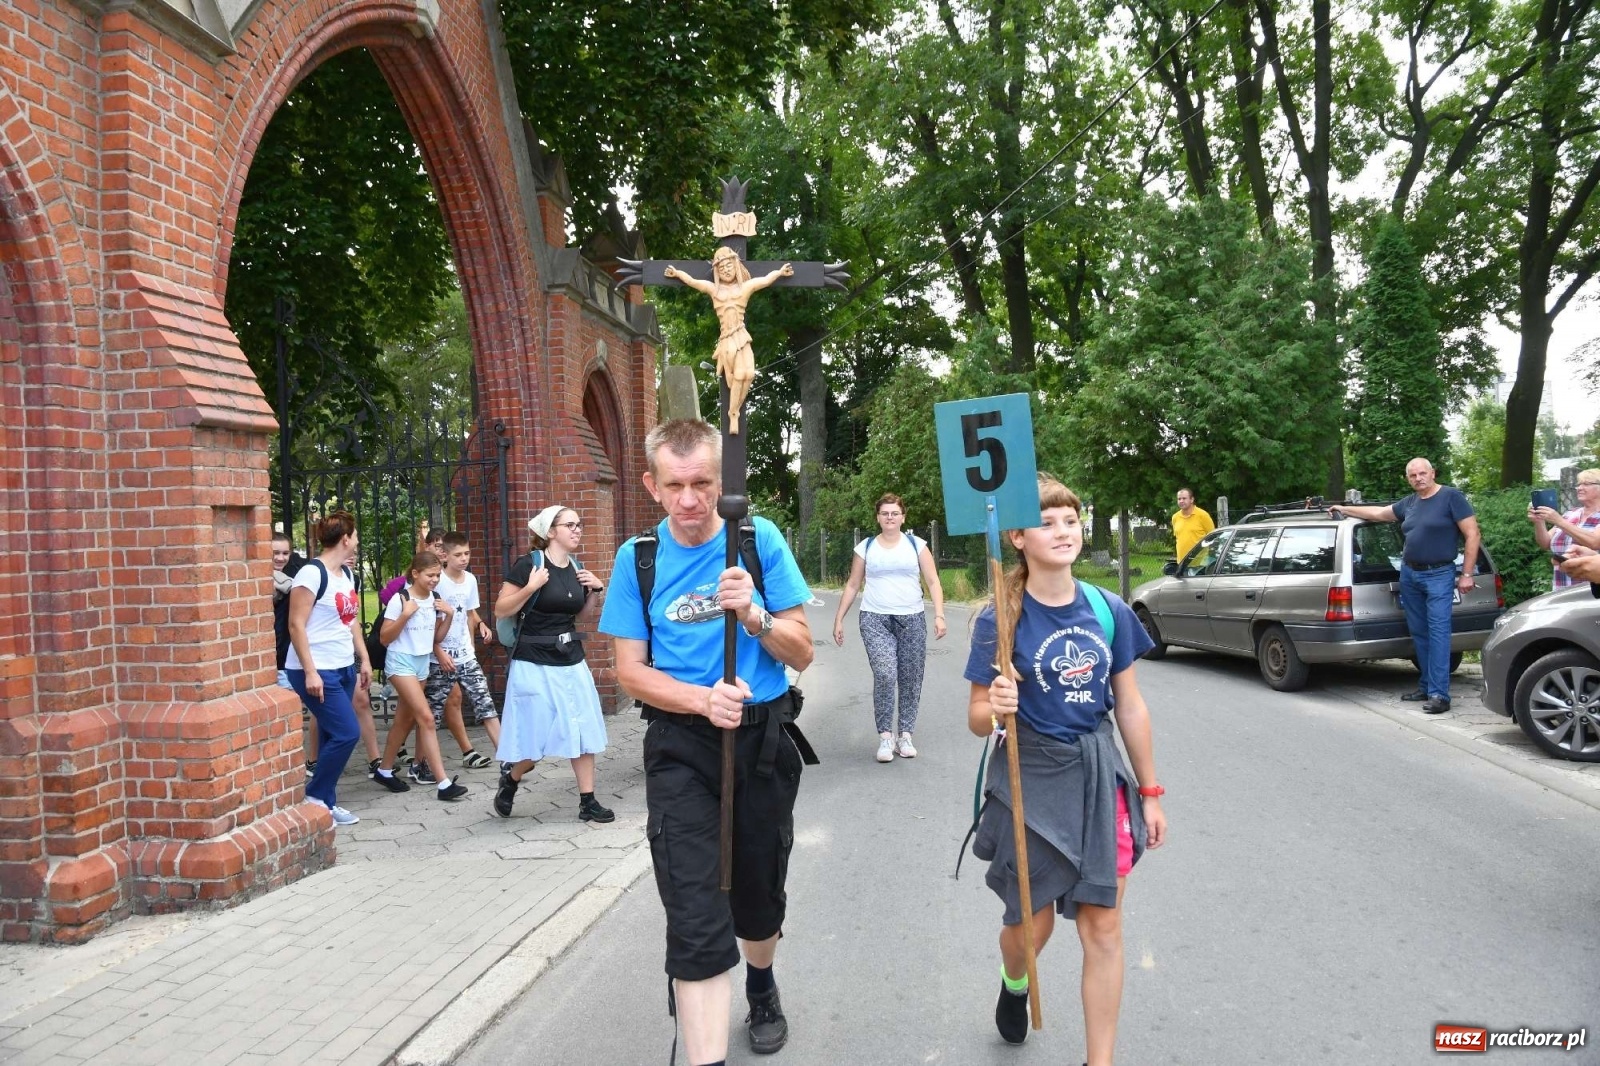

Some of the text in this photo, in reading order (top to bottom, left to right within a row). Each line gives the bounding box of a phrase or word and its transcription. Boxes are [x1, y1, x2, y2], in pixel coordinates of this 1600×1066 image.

[961, 410, 1008, 493] 5
[1034, 627, 1073, 661] Harcerstwa
[1033, 662, 1052, 693] Związek
[1064, 690, 1096, 703] ZHR
